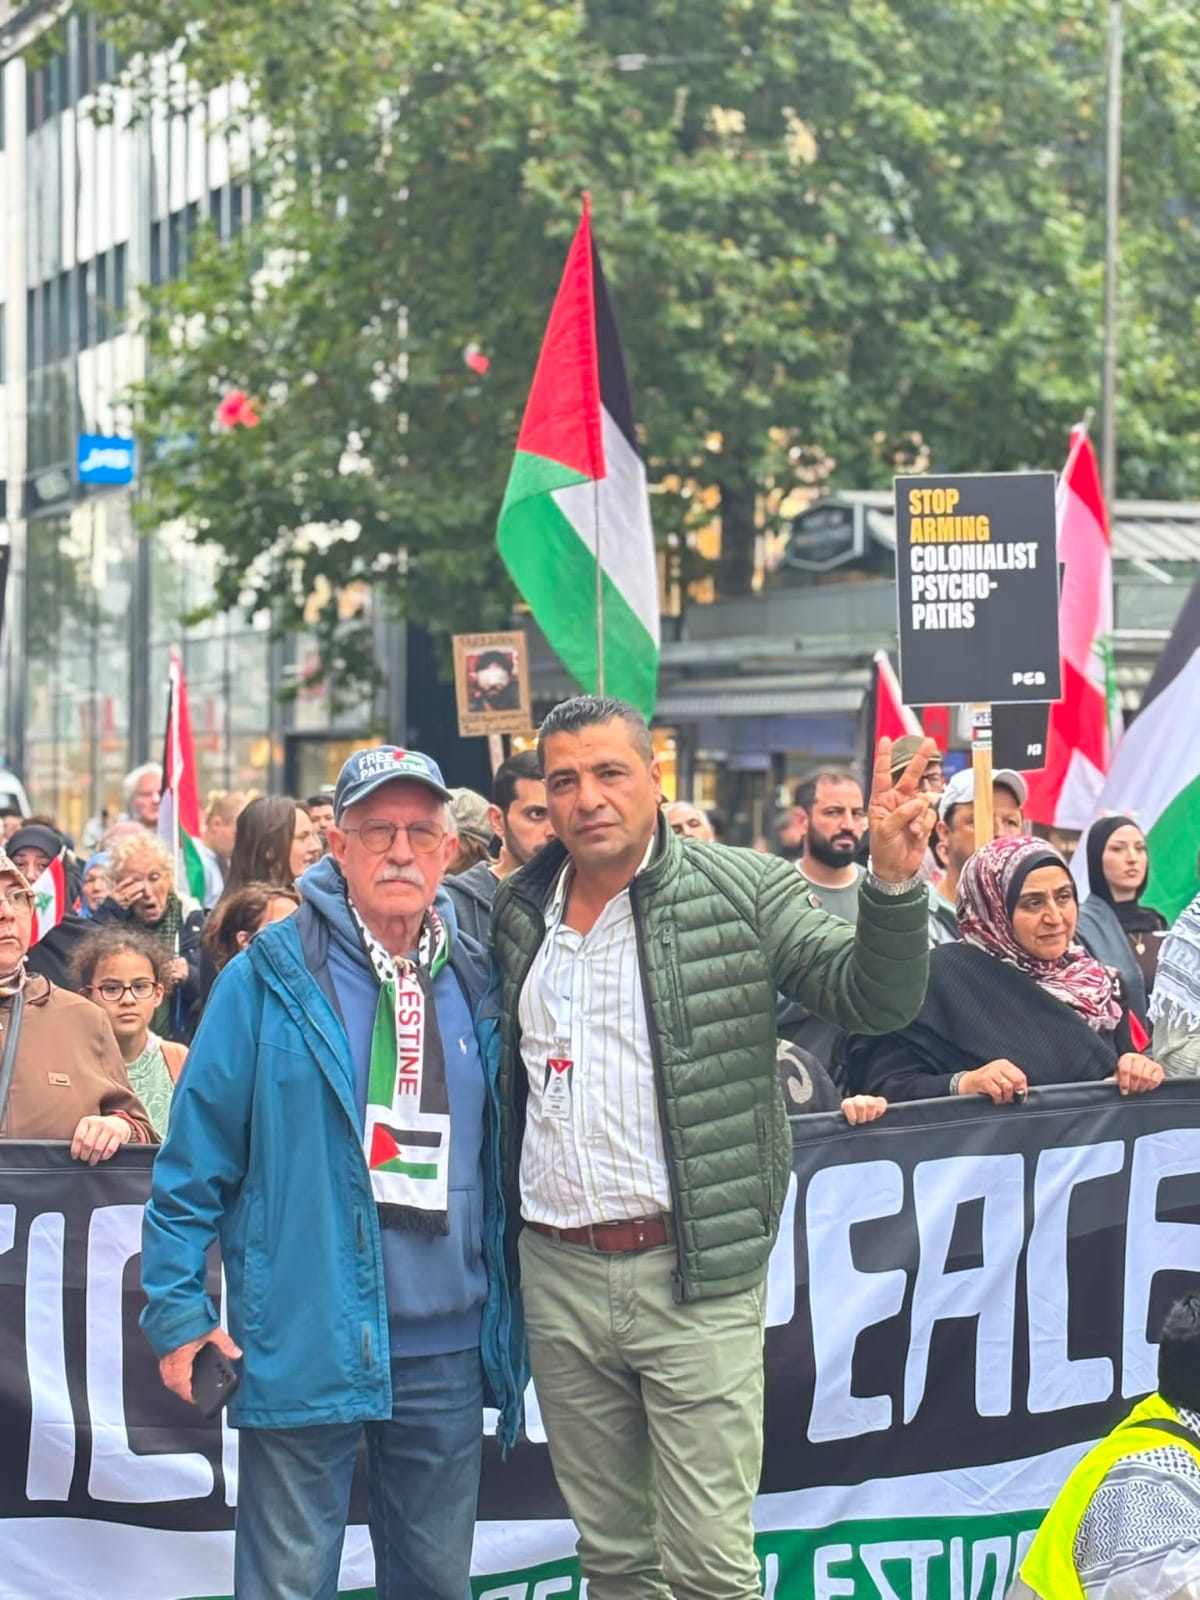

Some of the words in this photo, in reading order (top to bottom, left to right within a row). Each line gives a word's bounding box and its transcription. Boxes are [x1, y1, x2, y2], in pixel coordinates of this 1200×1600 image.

[908, 488, 960, 515] STOP
[910, 515, 990, 544] ARMING
[910, 542, 1039, 573] COLONIALIST
[911, 572, 998, 601] PSYCHO-
[912, 602, 976, 630] PATHS
[358, 751, 395, 770] FREE
[765, 1128, 1200, 1444] EACE
